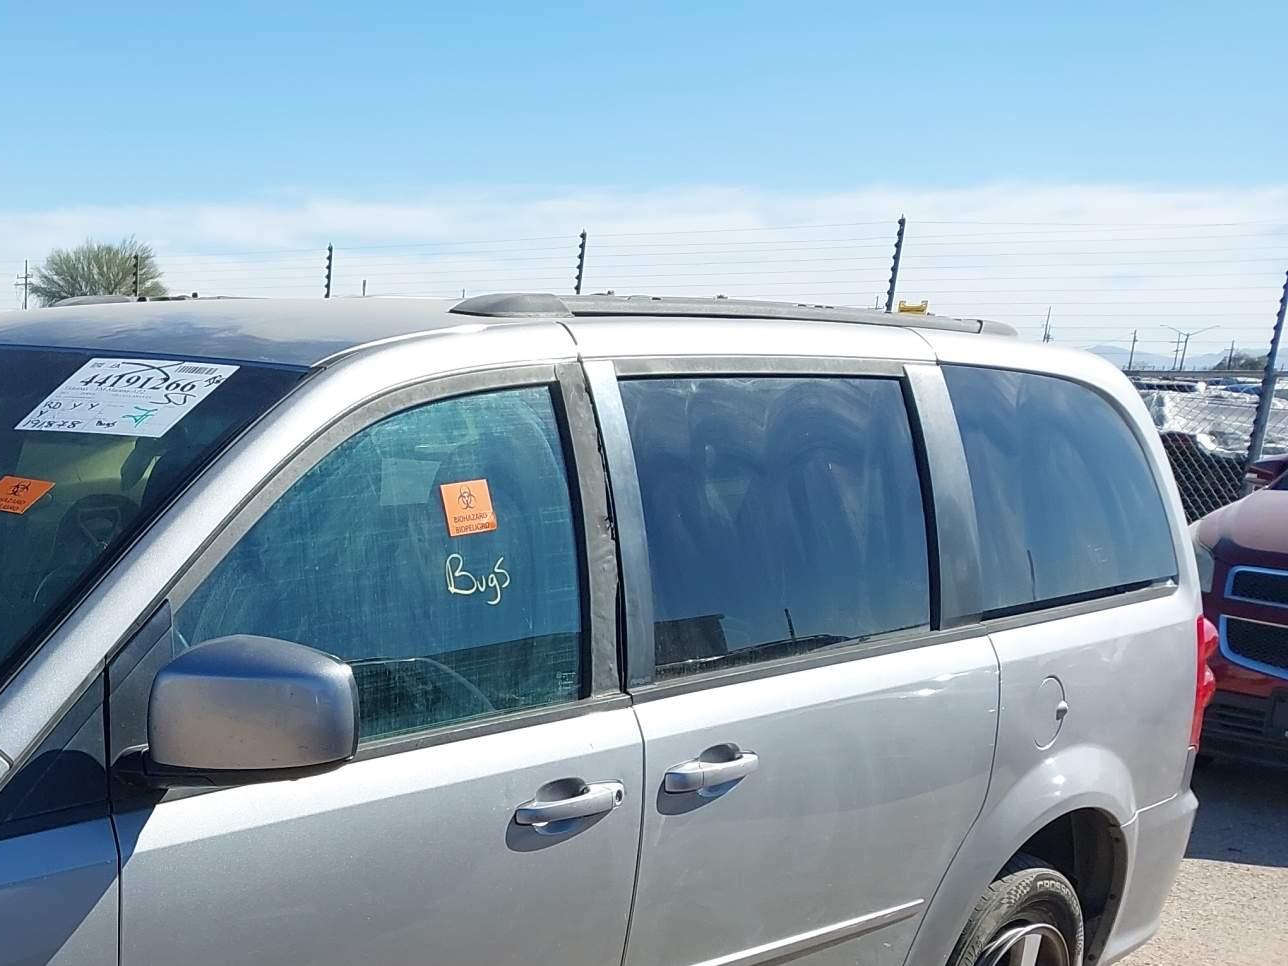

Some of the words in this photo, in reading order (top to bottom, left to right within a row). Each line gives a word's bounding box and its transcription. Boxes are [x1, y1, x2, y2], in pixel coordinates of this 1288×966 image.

[80, 373, 200, 392] 44191266
[453, 511, 488, 523] BIOHAZARD
[455, 521, 490, 534] BIOPELIGRO
[446, 554, 510, 605] Bugs
